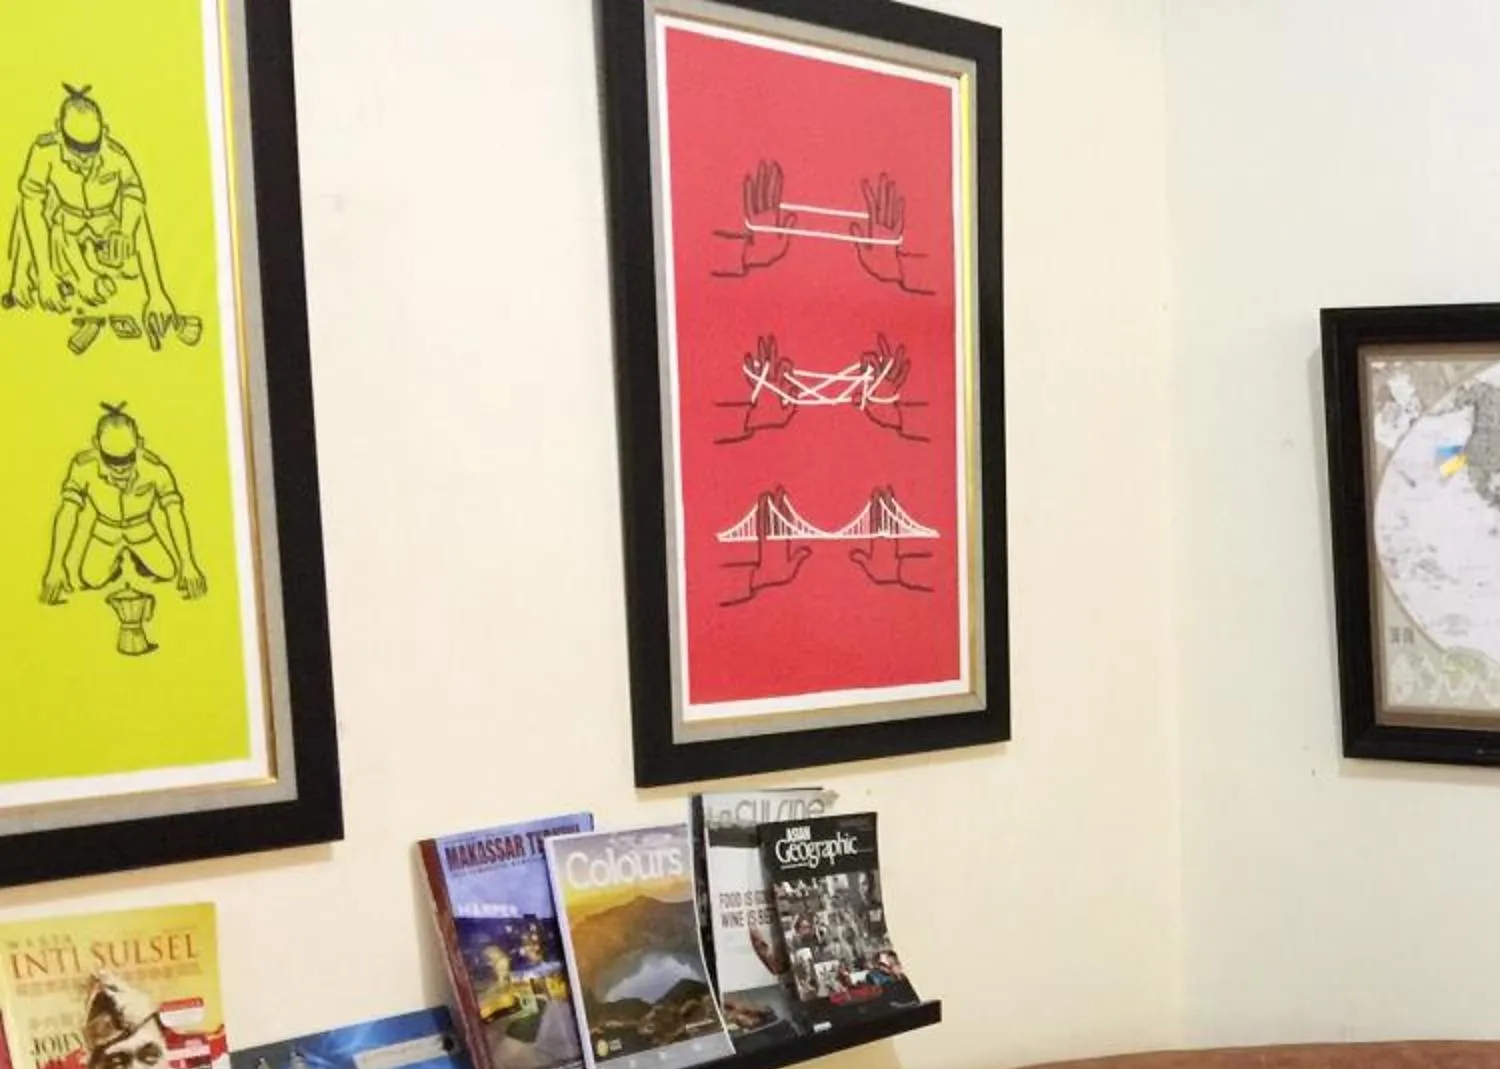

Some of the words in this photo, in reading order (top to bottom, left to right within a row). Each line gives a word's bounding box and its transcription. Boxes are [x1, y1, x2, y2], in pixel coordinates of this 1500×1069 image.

[444, 835, 526, 871] MAKASSAR
[775, 831, 858, 869] Geographic
[566, 847, 684, 891] Colours
[719, 891, 742, 908] FOOD
[744, 890, 753, 906] IS
[720, 911, 745, 929] WINE
[10, 946, 82, 979] INTI
[90, 932, 200, 969] SULSEL
